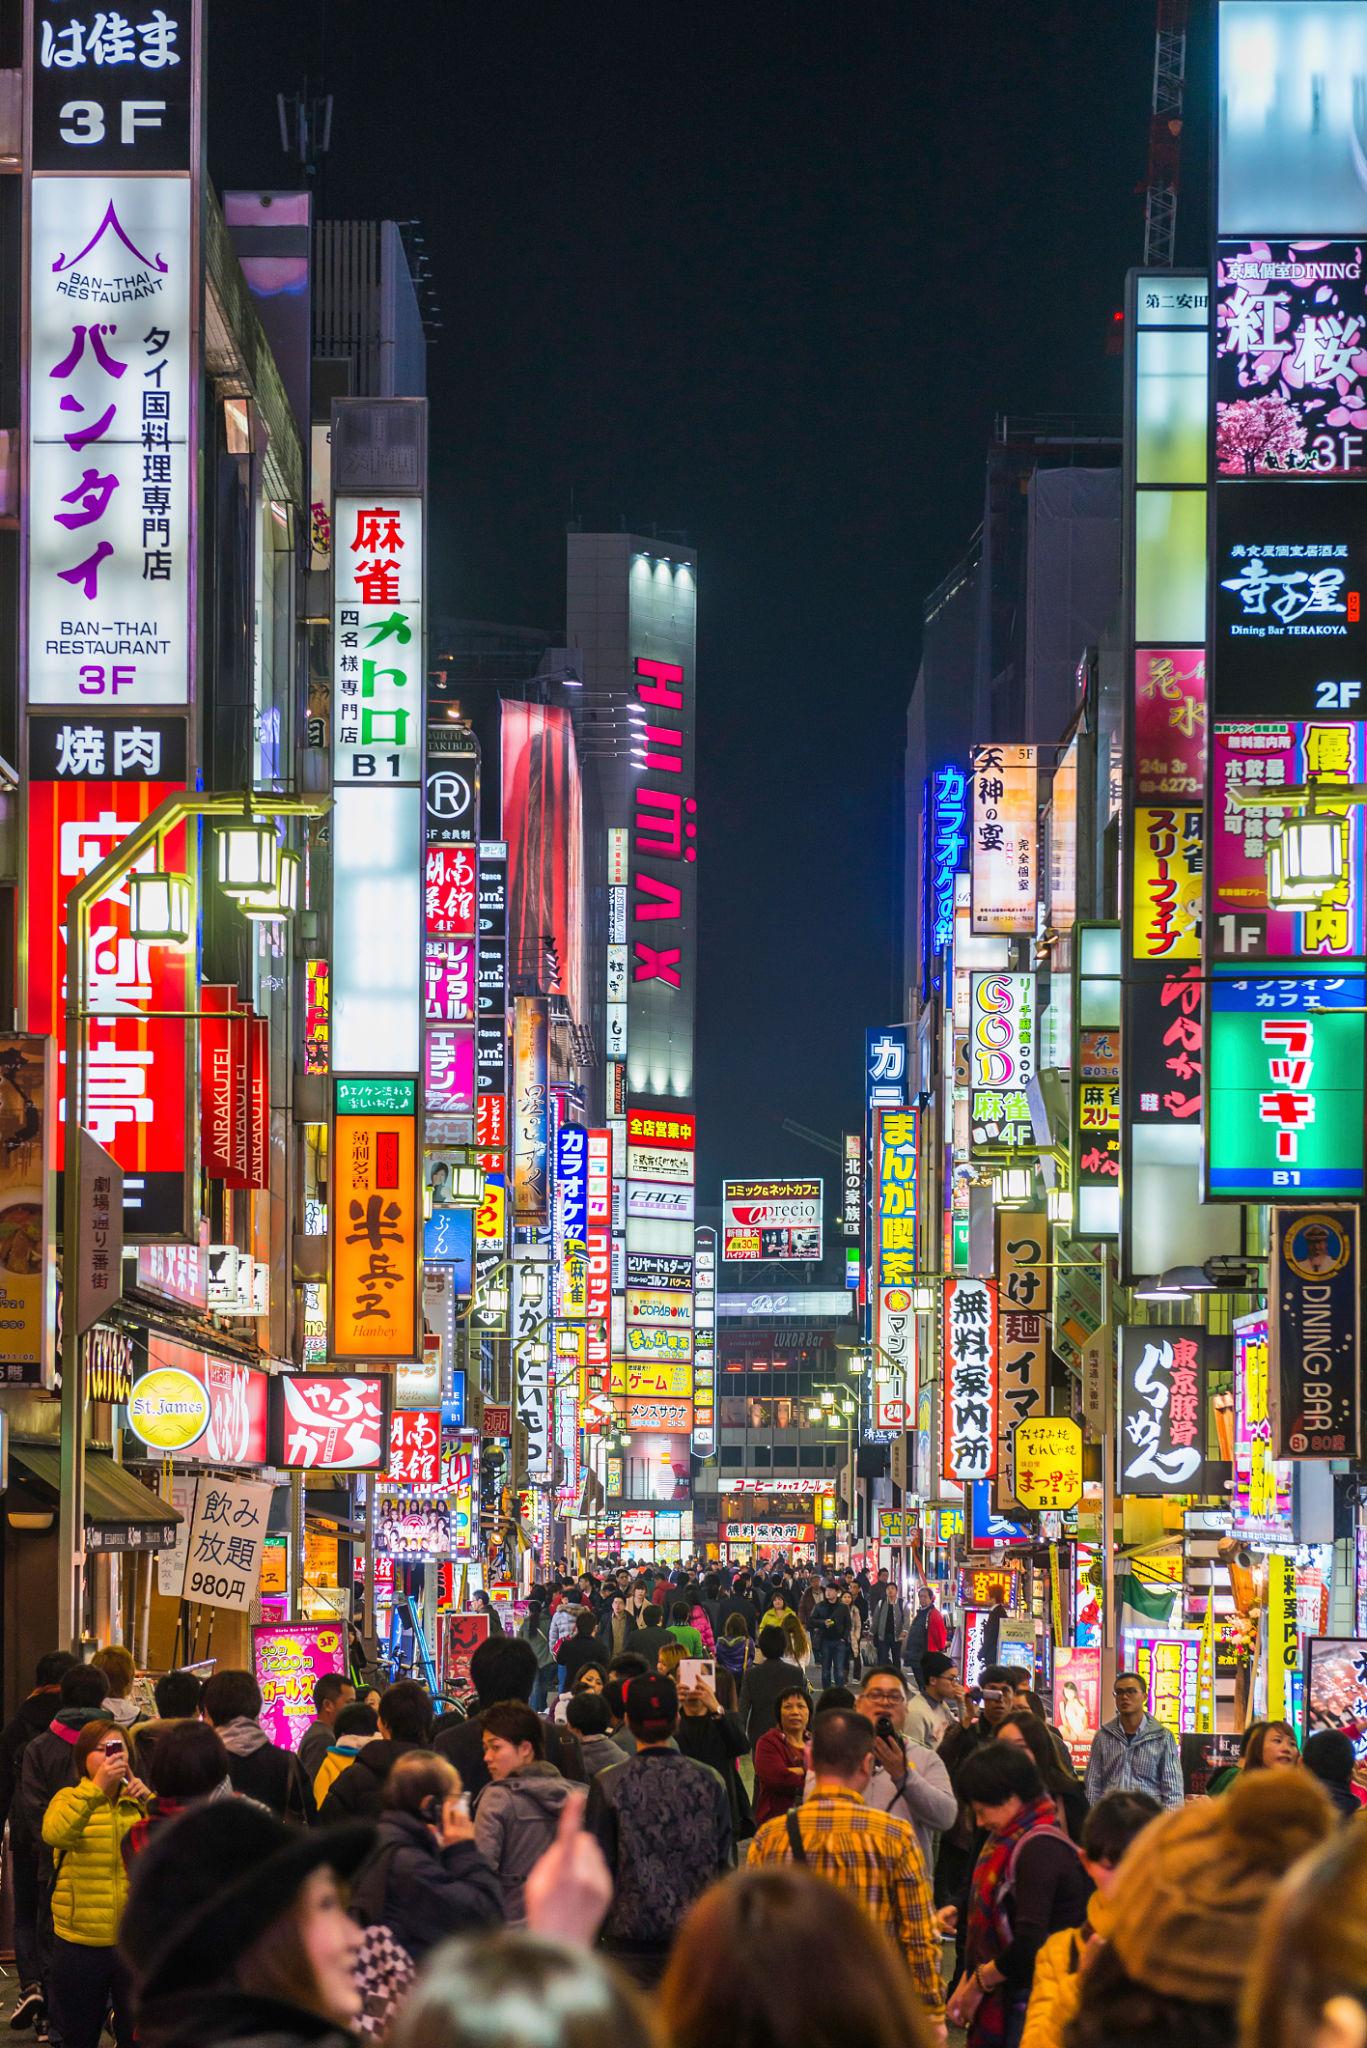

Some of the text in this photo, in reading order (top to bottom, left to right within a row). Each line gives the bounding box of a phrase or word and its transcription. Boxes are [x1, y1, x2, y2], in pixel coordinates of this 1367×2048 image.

[59, 100, 166, 144] 3F
[69, 271, 151, 290] BAN-THAI
[1227, 262, 1361, 280] 京風個室DINING
[56, 278, 163, 303] RESTAURANT
[1226, 287, 1363, 385] 紅桜
[50, 323, 128, 601] バンタイ
[142, 326, 172, 582] タイ国料理専門店
[1312, 435, 1364, 472] 3F
[350, 506, 405, 605] 麻雀
[60, 621, 158, 636] BAN-THAI
[1231, 625, 1348, 637] Dining Bar TERAKOYA
[46, 640, 171, 655] RESTAURANT
[78, 664, 137, 695] 3F
[340, 610, 360, 744] 四名様専門店
[1315, 682, 1362, 709] 2F
[55, 725, 161, 776] 焼肉
[1017, 748, 1034, 760] 5F
[1228, 736, 1292, 750] 無料案内所
[352, 753, 400, 777] B1
[976, 747, 1004, 852] 天神の宴
[441, 829, 471, 840] 会員制
[1017, 838, 1030, 892] 完全個室
[1146, 809, 1181, 956] スリーファイブ
[434, 920, 456, 931] 4F
[1218, 914, 1261, 953] 1F
[446, 942, 469, 1020] レンタル
[1017, 977, 1032, 1045] リーチ麻雀
[1255, 992, 1321, 1008] カフェ
[974, 974, 1015, 1087] GOD
[429, 1031, 456, 1090] エデン
[213, 1049, 231, 1161] ANRAKUTEI
[972, 1090, 1032, 1123] 麻雀
[1262, 1020, 1315, 1162] ラッキー
[630, 1118, 692, 1141] 全店営業中
[998, 1122, 1032, 1146] 4F
[560, 1130, 584, 1222] カラオケ
[727, 1184, 820, 1197] コミック&ネットカフェ
[844, 1159, 861, 1222] 北の家族
[1272, 1170, 1301, 1186] B1
[630, 1190, 692, 1205] FACE
[882, 1112, 915, 1285] まんが喫茶
[91, 1176, 112, 1290] 劇場通り一番街
[352, 1324, 398, 1338] Hanbey
[1302, 1284, 1333, 1432] DINING BAR
[628, 1373, 668, 1391] ゲーム
[952, 1288, 990, 1471] 無料案内所
[1168, 1338, 1199, 1447] 東京豚骨
[630, 1404, 688, 1418] メンズサウナ
[201, 1489, 260, 1528] 飲み
[1039, 1495, 1058, 1505] B1
[624, 1525, 653, 1535] ゲーム
[726, 1524, 798, 1537] 無料案内所
[193, 1530, 258, 1572] 放題
[190, 1571, 246, 1603] 980円
[319, 1635, 335, 1648] 3F
[262, 1674, 317, 1704] ガールズ
